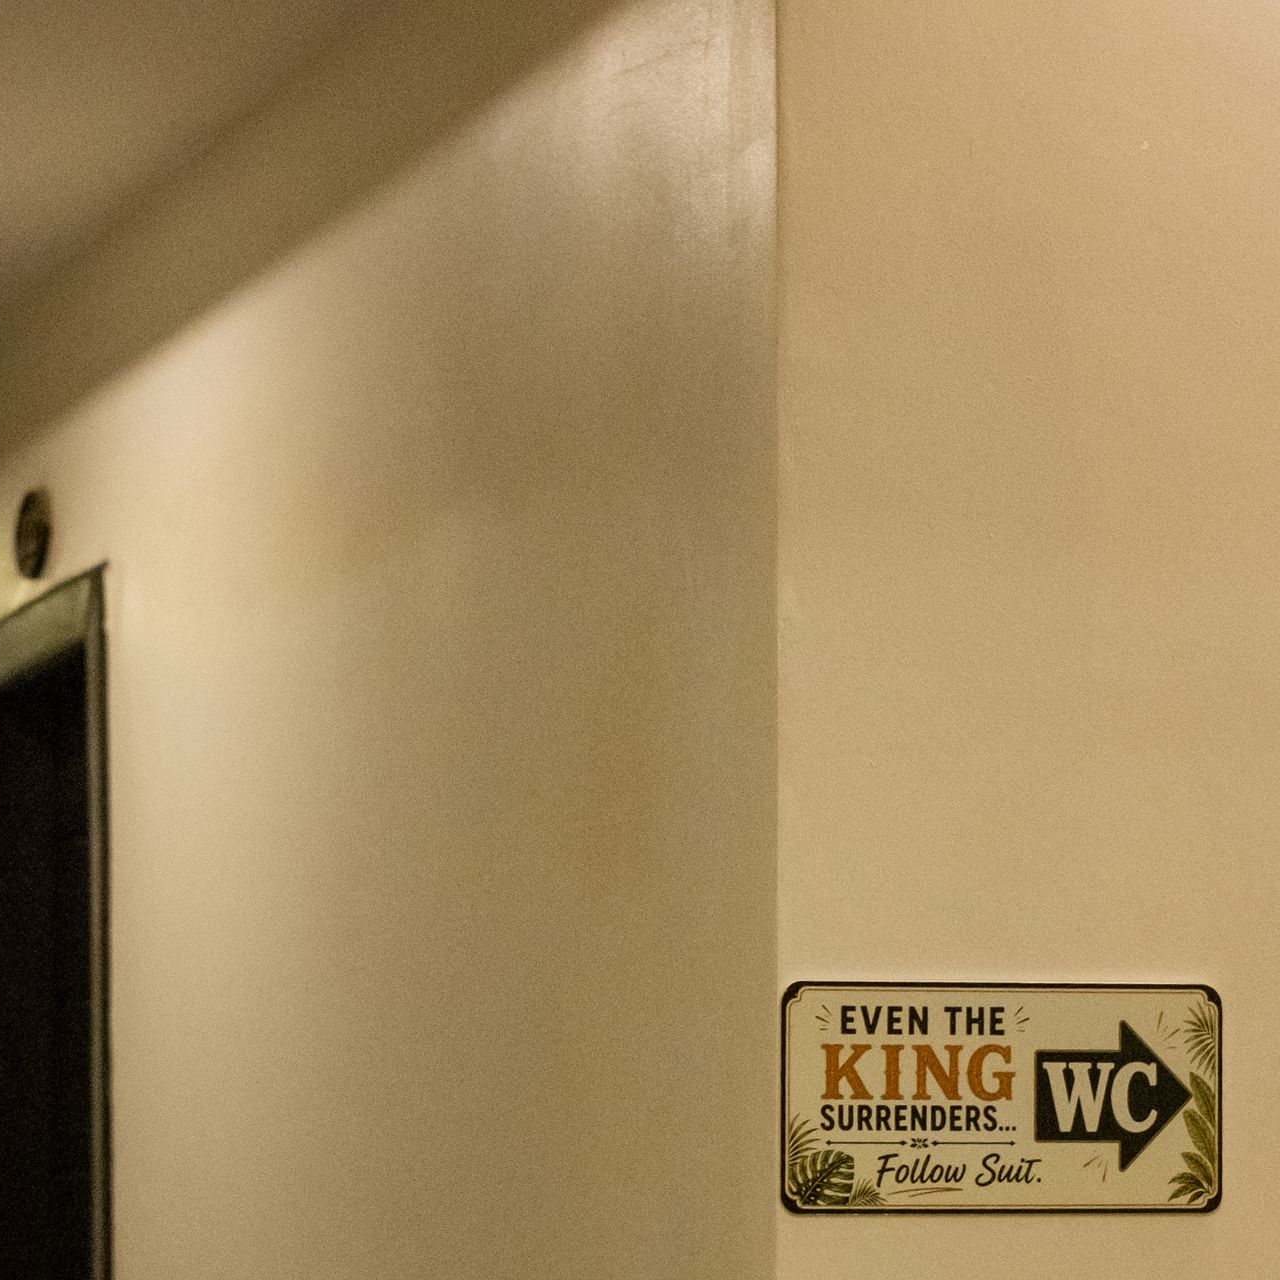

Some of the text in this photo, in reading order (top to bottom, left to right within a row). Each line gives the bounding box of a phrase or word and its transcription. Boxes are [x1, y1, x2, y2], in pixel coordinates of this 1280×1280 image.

[840, 1005, 1005, 1036] EVEN THE
[820, 1043, 1016, 1101] KING
[1043, 1061, 1158, 1133] WC
[820, 1104, 1017, 1132] SURRENDERS...
[876, 1153, 1042, 1187] Follow Suit.
